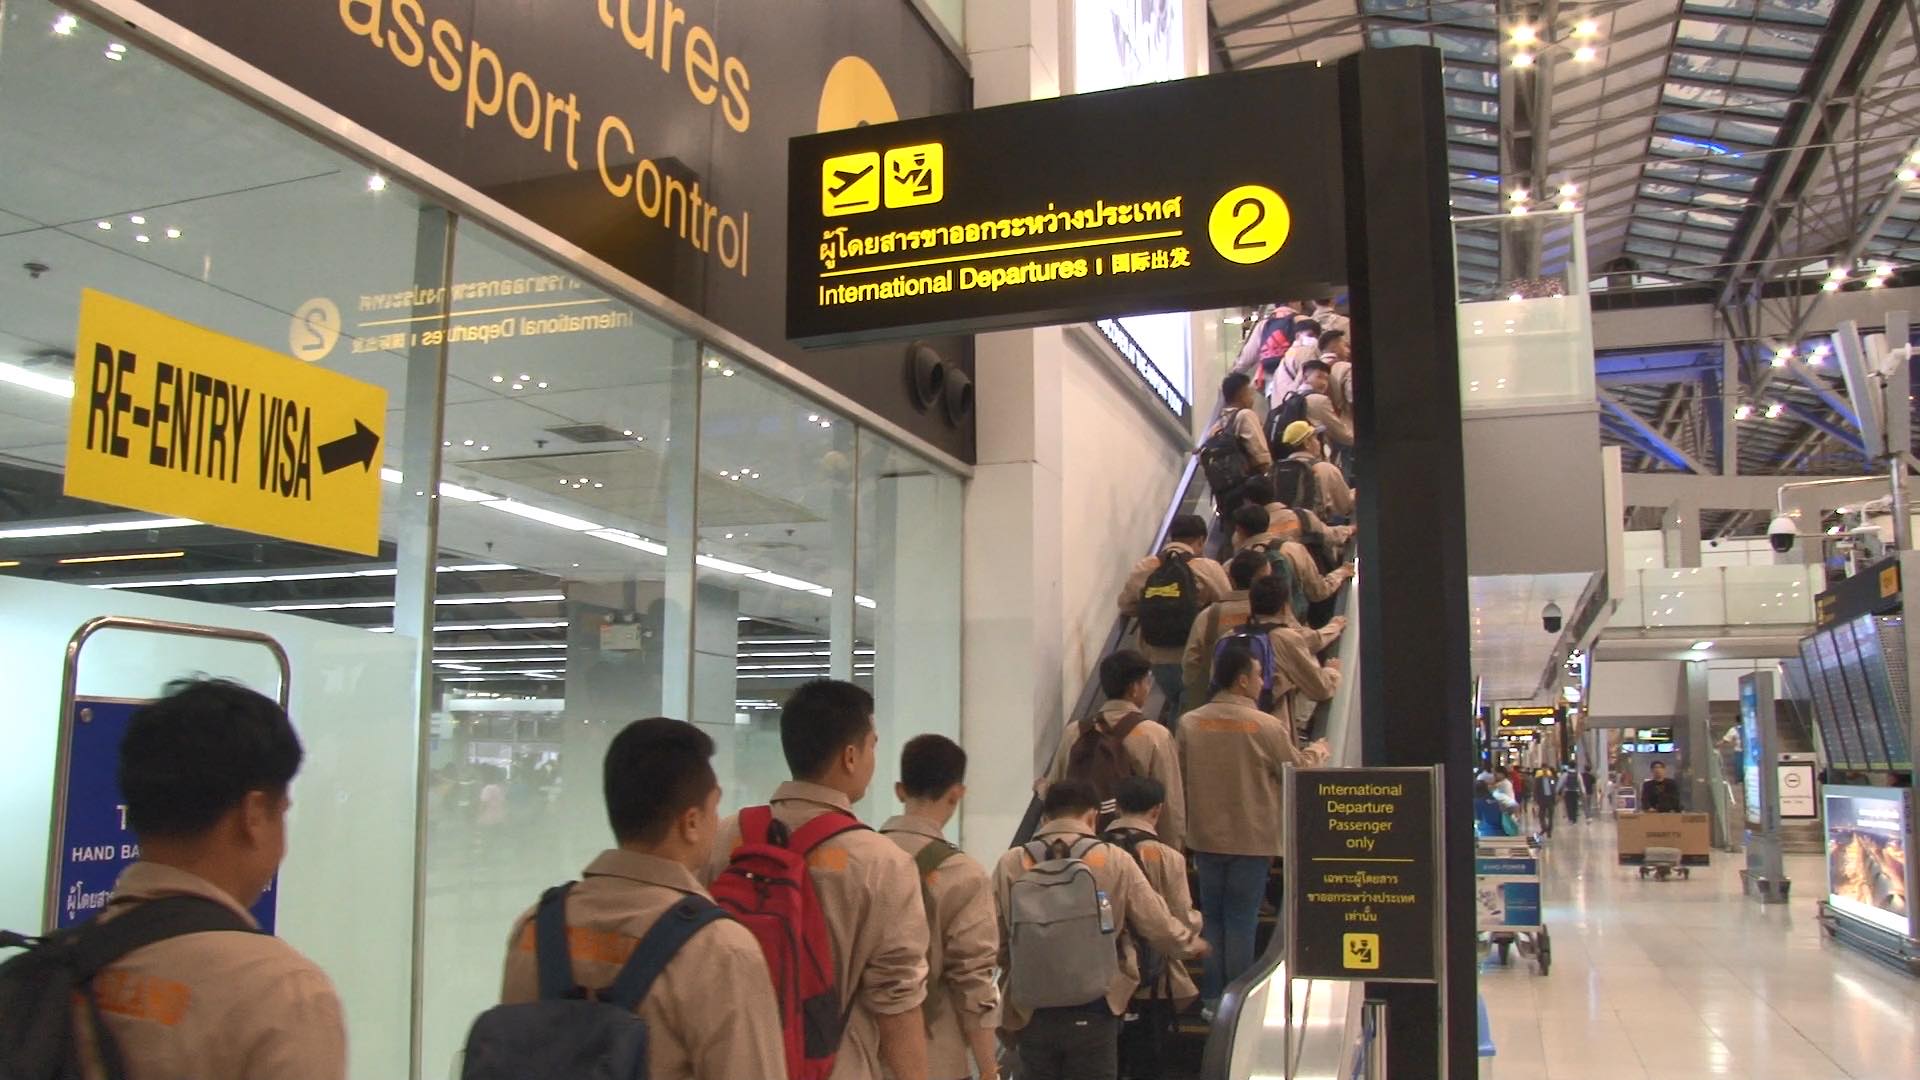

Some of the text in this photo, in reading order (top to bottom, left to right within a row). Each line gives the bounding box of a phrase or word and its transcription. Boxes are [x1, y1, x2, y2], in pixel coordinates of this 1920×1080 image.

[597, 115, 749, 277] Control
[819, 194, 1182, 270] ผู้โดยสารขาออกระหว่างประเทศ
[1231, 197, 1267, 251] 2
[1111, 247, 1191, 275] 国际出发
[819, 258, 1088, 306] International Departures
[86, 342, 312, 501] RE-ENTRY VISA
[1319, 784, 1403, 796] International
[1327, 801, 1395, 815] Departure
[1328, 819, 1393, 833] Passenger
[72, 845, 115, 862] HAND
[1346, 837, 1376, 850] only
